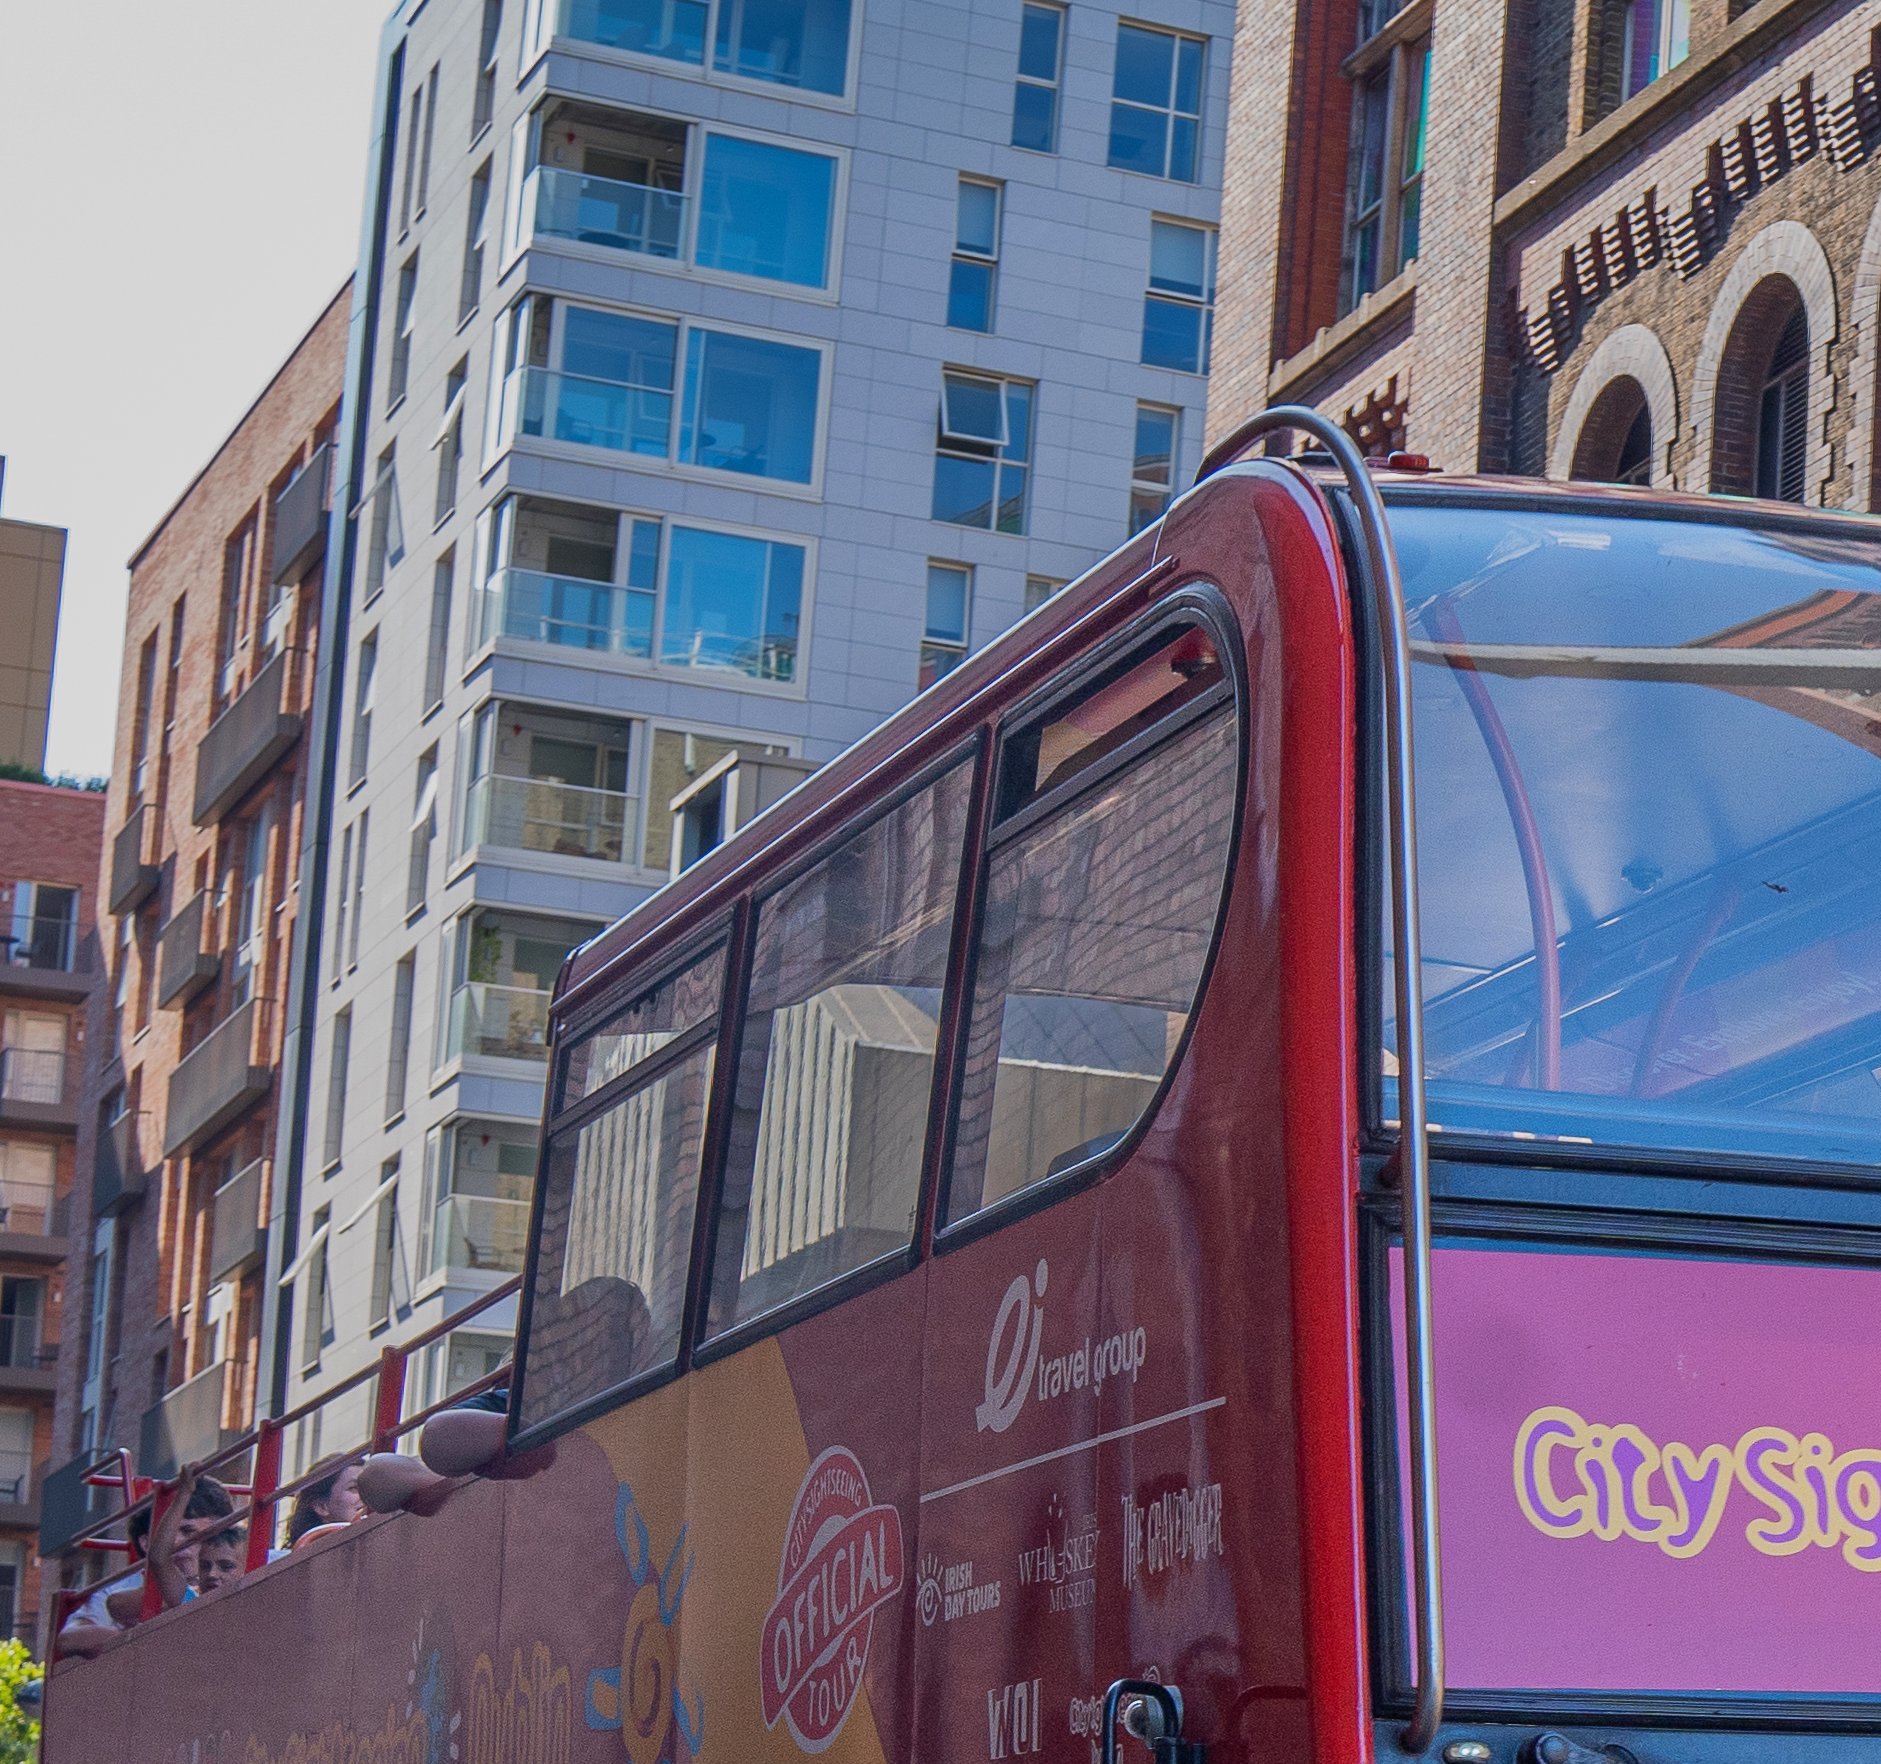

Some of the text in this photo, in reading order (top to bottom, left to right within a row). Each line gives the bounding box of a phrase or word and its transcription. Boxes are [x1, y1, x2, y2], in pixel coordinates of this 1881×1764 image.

[1038, 1326, 1147, 1402] travel group
[773, 1520, 895, 1694] OFFICIAL
[944, 1560, 974, 1594] IRISH
[944, 1580, 1001, 1622] DAY TOURS
[807, 1636, 864, 1727] TOUR
[987, 1677, 1042, 1760] WOI
